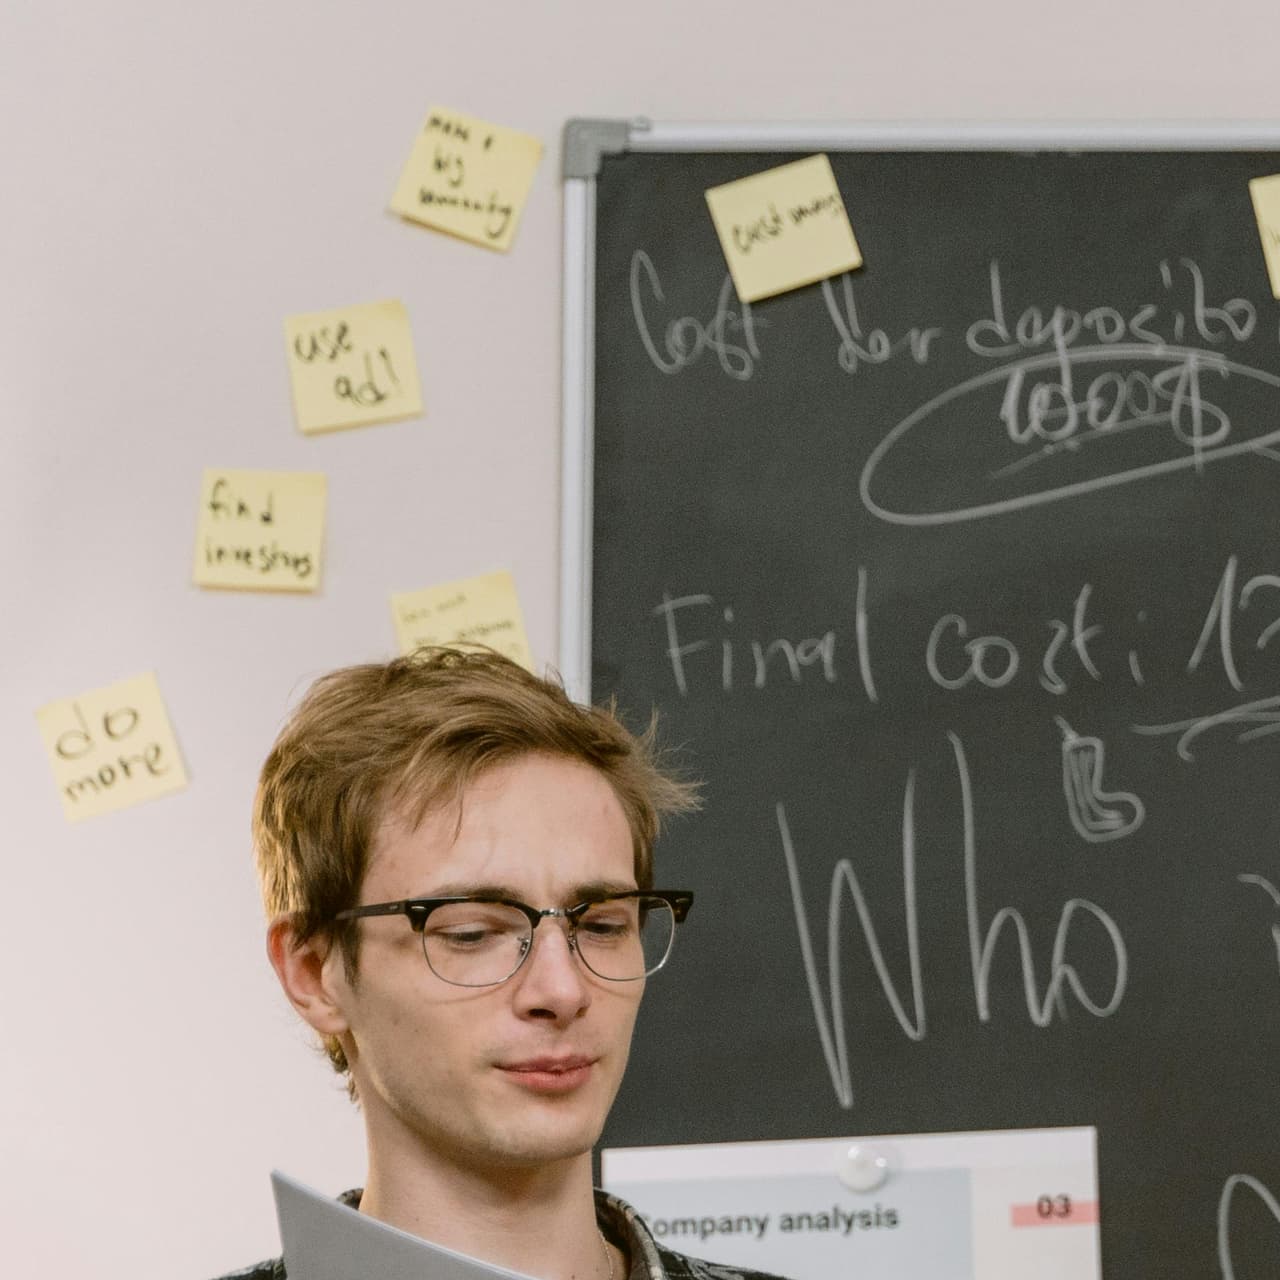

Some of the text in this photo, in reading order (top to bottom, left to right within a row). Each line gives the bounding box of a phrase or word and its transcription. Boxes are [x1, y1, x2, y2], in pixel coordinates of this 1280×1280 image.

[294, 322, 353, 364] use
[209, 477, 275, 526] find
[655, 565, 879, 704] Final
[56, 700, 139, 761] do
[64, 741, 170, 803] more
[775, 729, 1128, 1110] Who
[779, 1203, 898, 1237] analysis
[1037, 1193, 1071, 1219] 03
